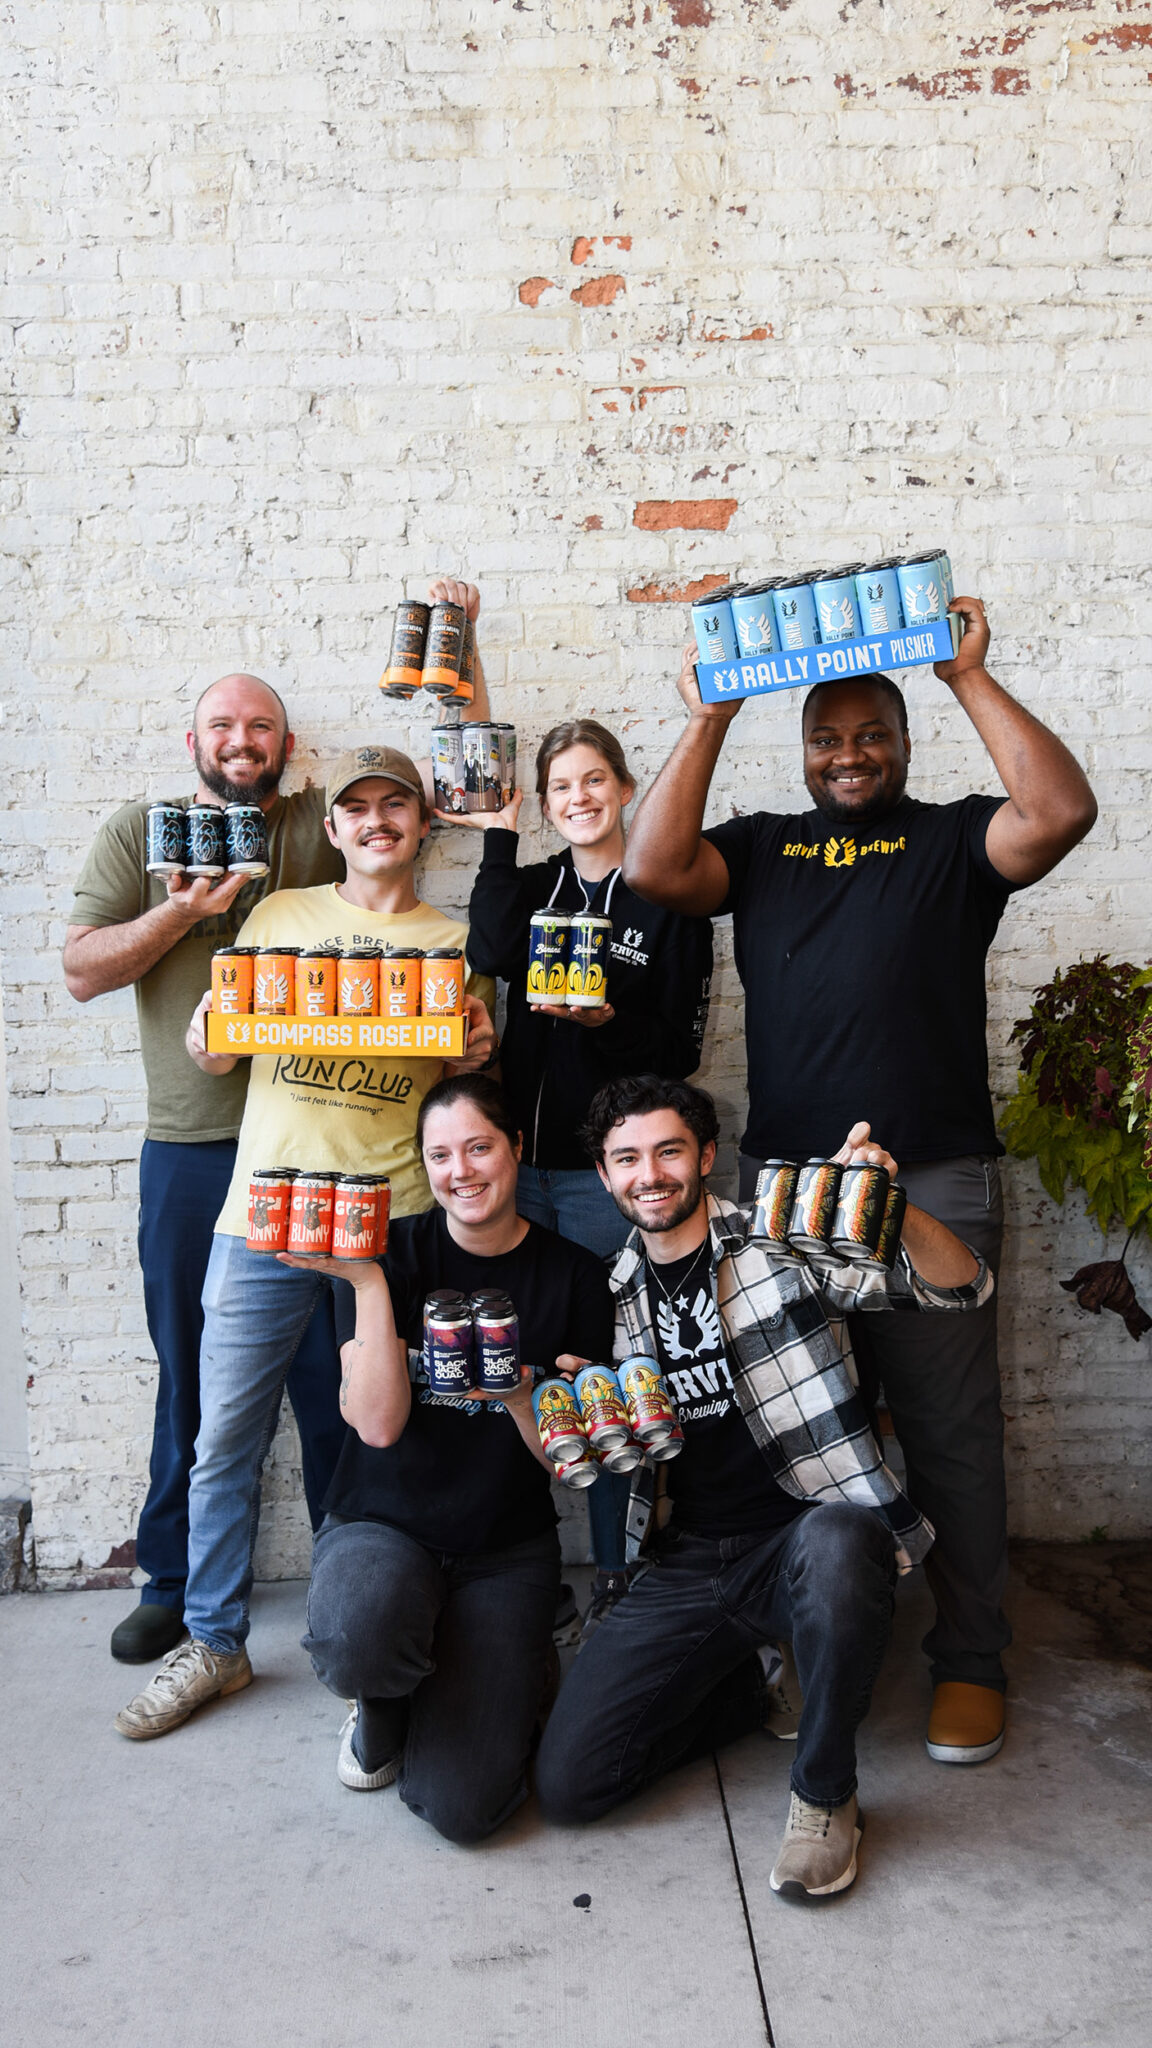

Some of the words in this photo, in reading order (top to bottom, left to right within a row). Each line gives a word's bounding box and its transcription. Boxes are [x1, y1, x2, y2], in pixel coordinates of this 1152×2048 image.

[870, 604, 889, 635] ILSNER
[741, 655, 810, 689] RALLY
[817, 642, 883, 677] POINT
[889, 632, 936, 664] PILSNER
[610, 941, 649, 966] ERVICE
[254, 1022, 353, 1047] COMPASS
[359, 1024, 412, 1047] ROSE
[416, 1025, 451, 1048] IPA
[295, 1094, 311, 1103] just
[312, 1097, 327, 1106] felt
[328, 1099, 344, 1108] like
[291, 1222, 330, 1243] BUNNY
[334, 1227, 374, 1249] BUNNY
[434, 1358, 467, 1368] BLACK
[483, 1354, 516, 1364] BLACK
[484, 1362, 511, 1370] JACK
[435, 1365, 461, 1373] JACK
[435, 1371, 465, 1379] QUAD
[484, 1367, 514, 1376] QUAD
[678, 1399, 731, 1423] Brewing
